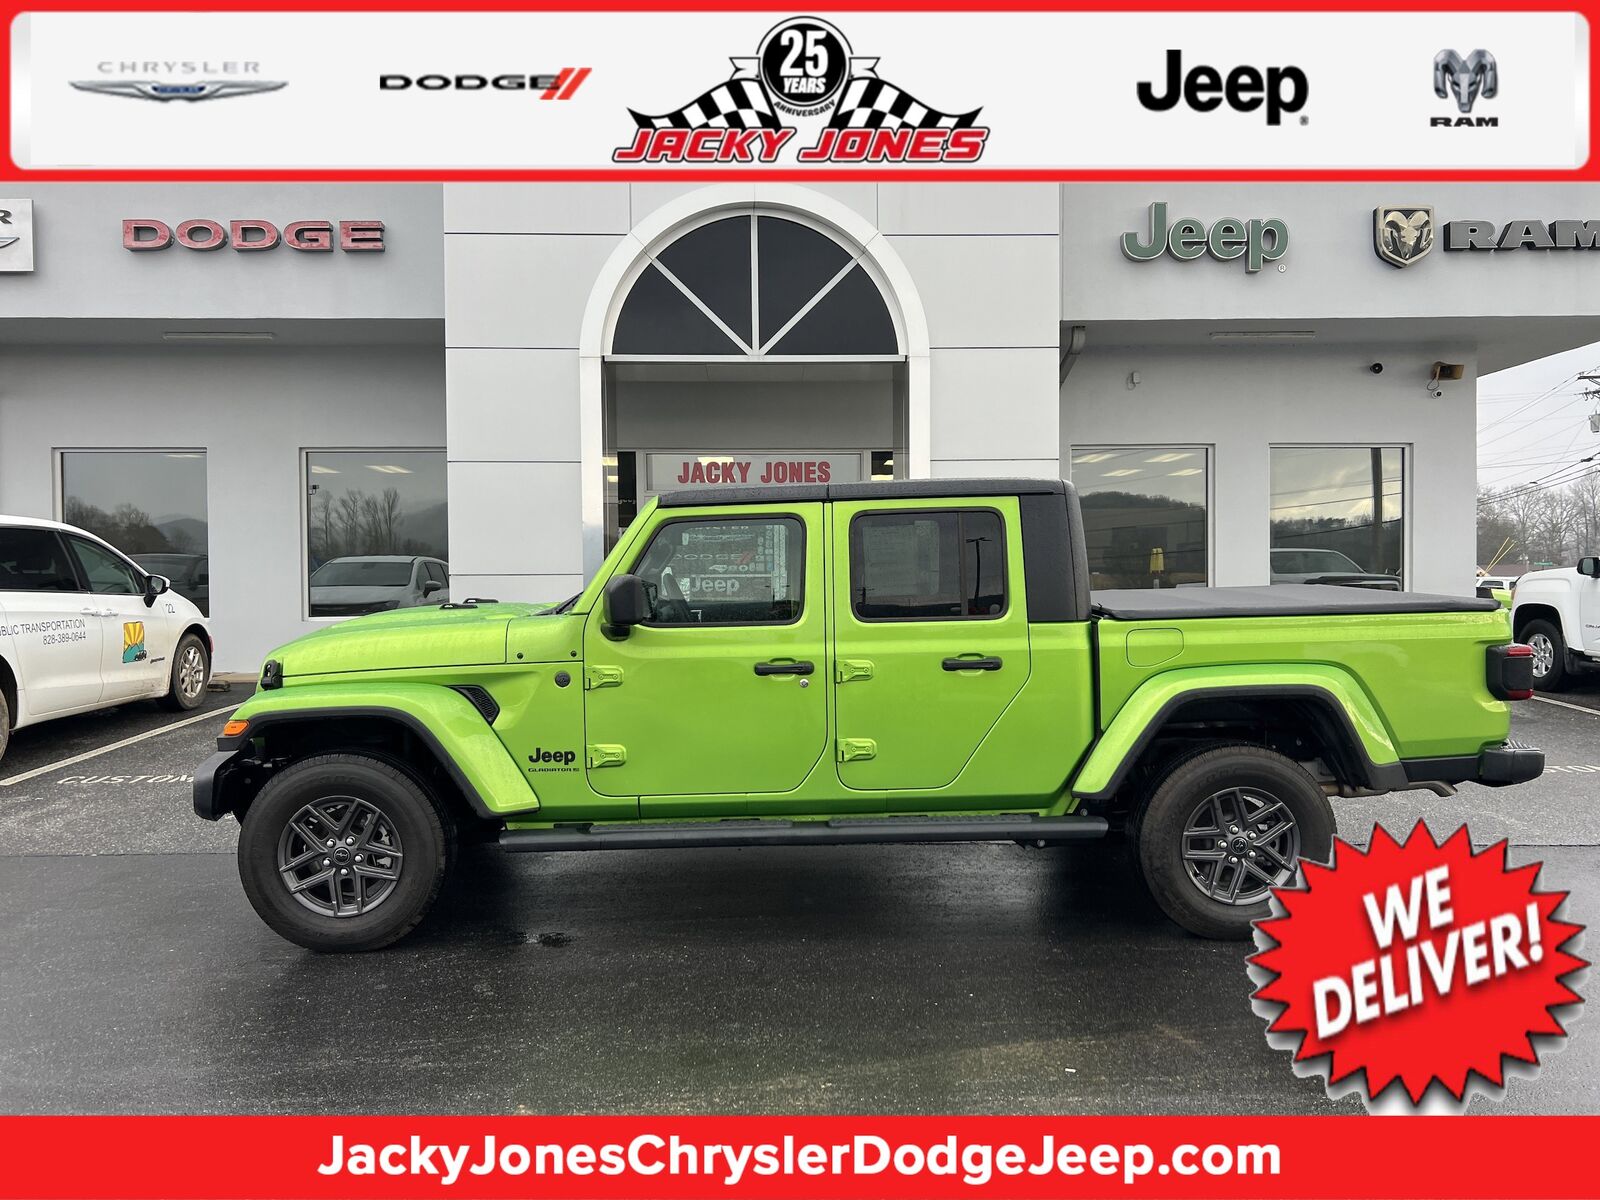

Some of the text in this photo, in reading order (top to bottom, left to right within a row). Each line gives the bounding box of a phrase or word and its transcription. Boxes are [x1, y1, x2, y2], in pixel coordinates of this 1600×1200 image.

[122, 218, 386, 252] DODGE
[1120, 202, 1290, 273] Jeep
[1444, 219, 1600, 252] RAM
[677, 461, 831, 484] JACKY JONES
[690, 576, 740, 596] Jeep
[20, 618, 86, 635] TRANSPORTATION
[43, 631, 87, 646] 828-389-0644
[528, 747, 576, 766] Jeep
